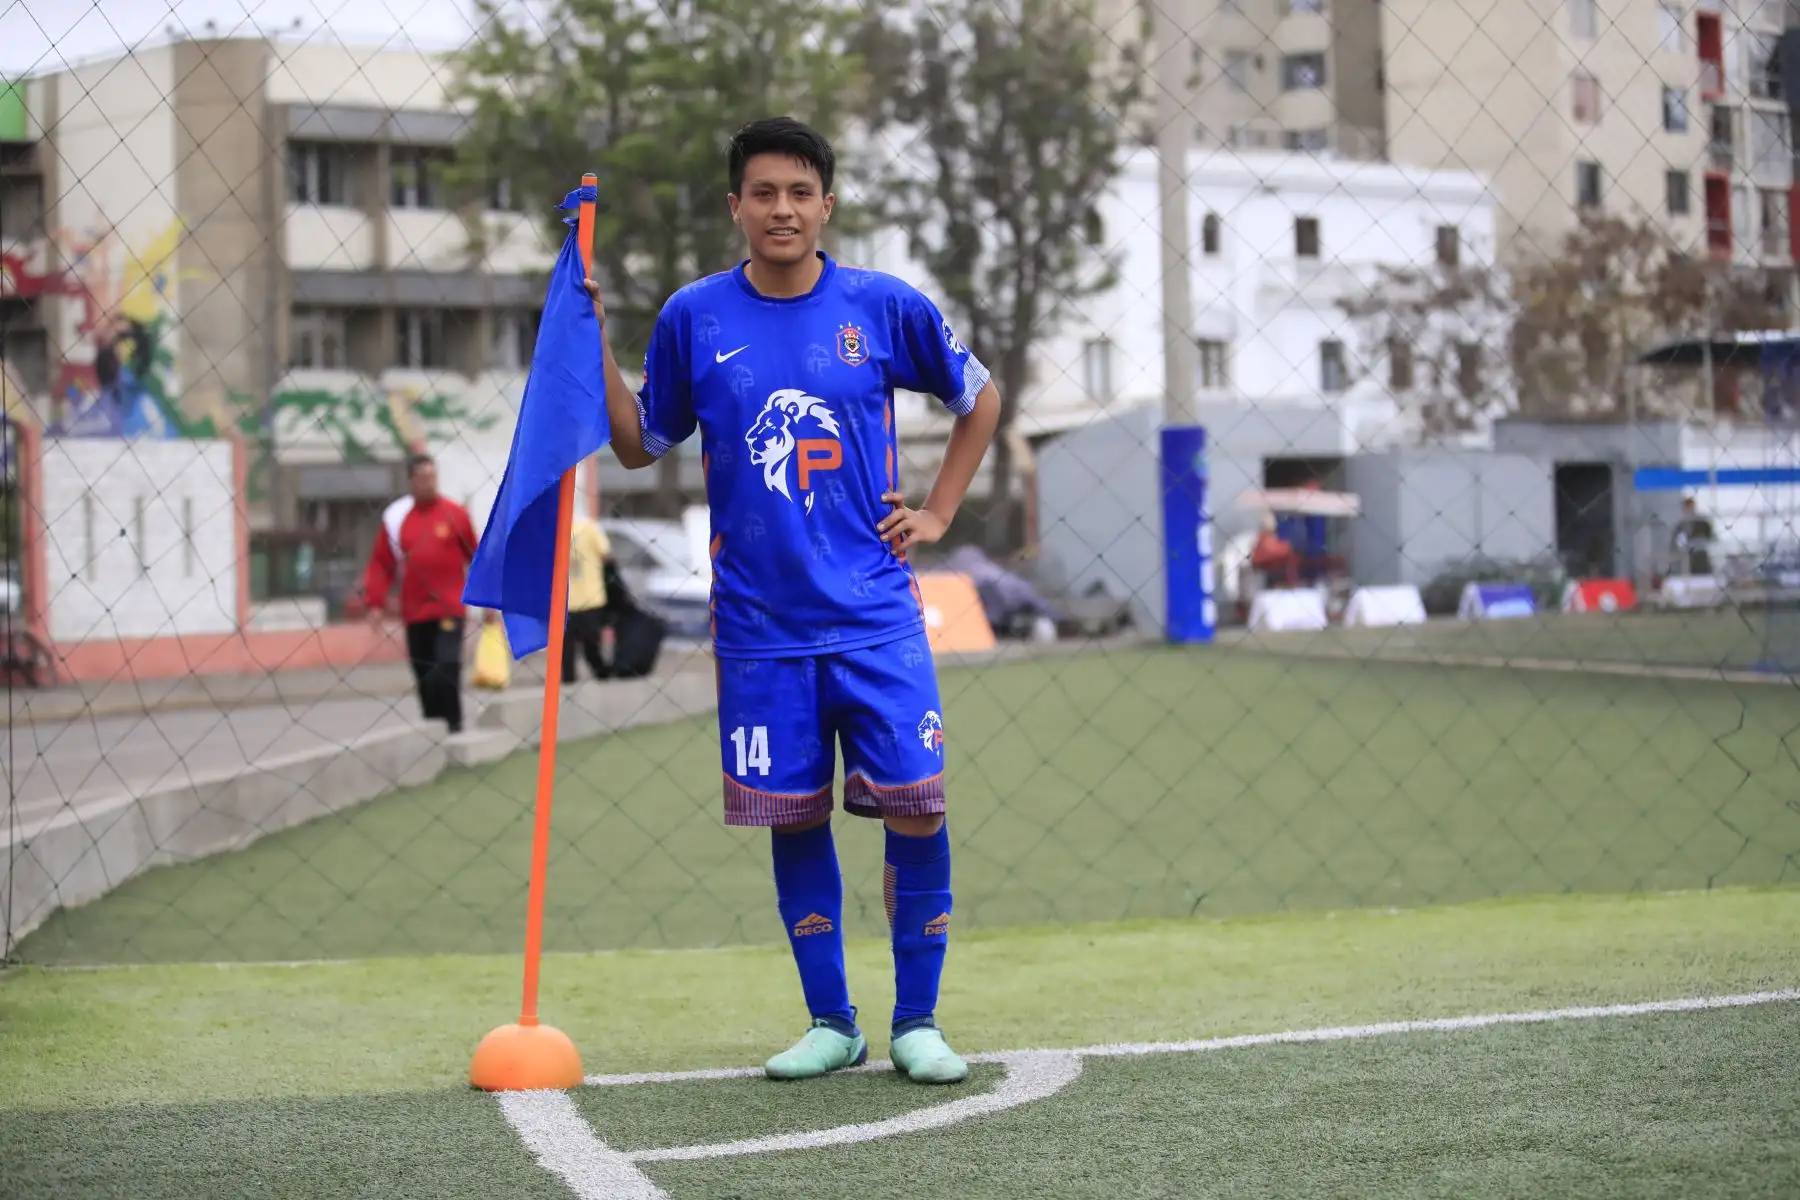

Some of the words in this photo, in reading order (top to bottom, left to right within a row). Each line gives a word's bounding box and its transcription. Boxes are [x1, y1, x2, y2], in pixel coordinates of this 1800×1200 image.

[797, 439, 842, 490] P
[731, 726, 772, 777] 14
[794, 923, 833, 937] DECO
